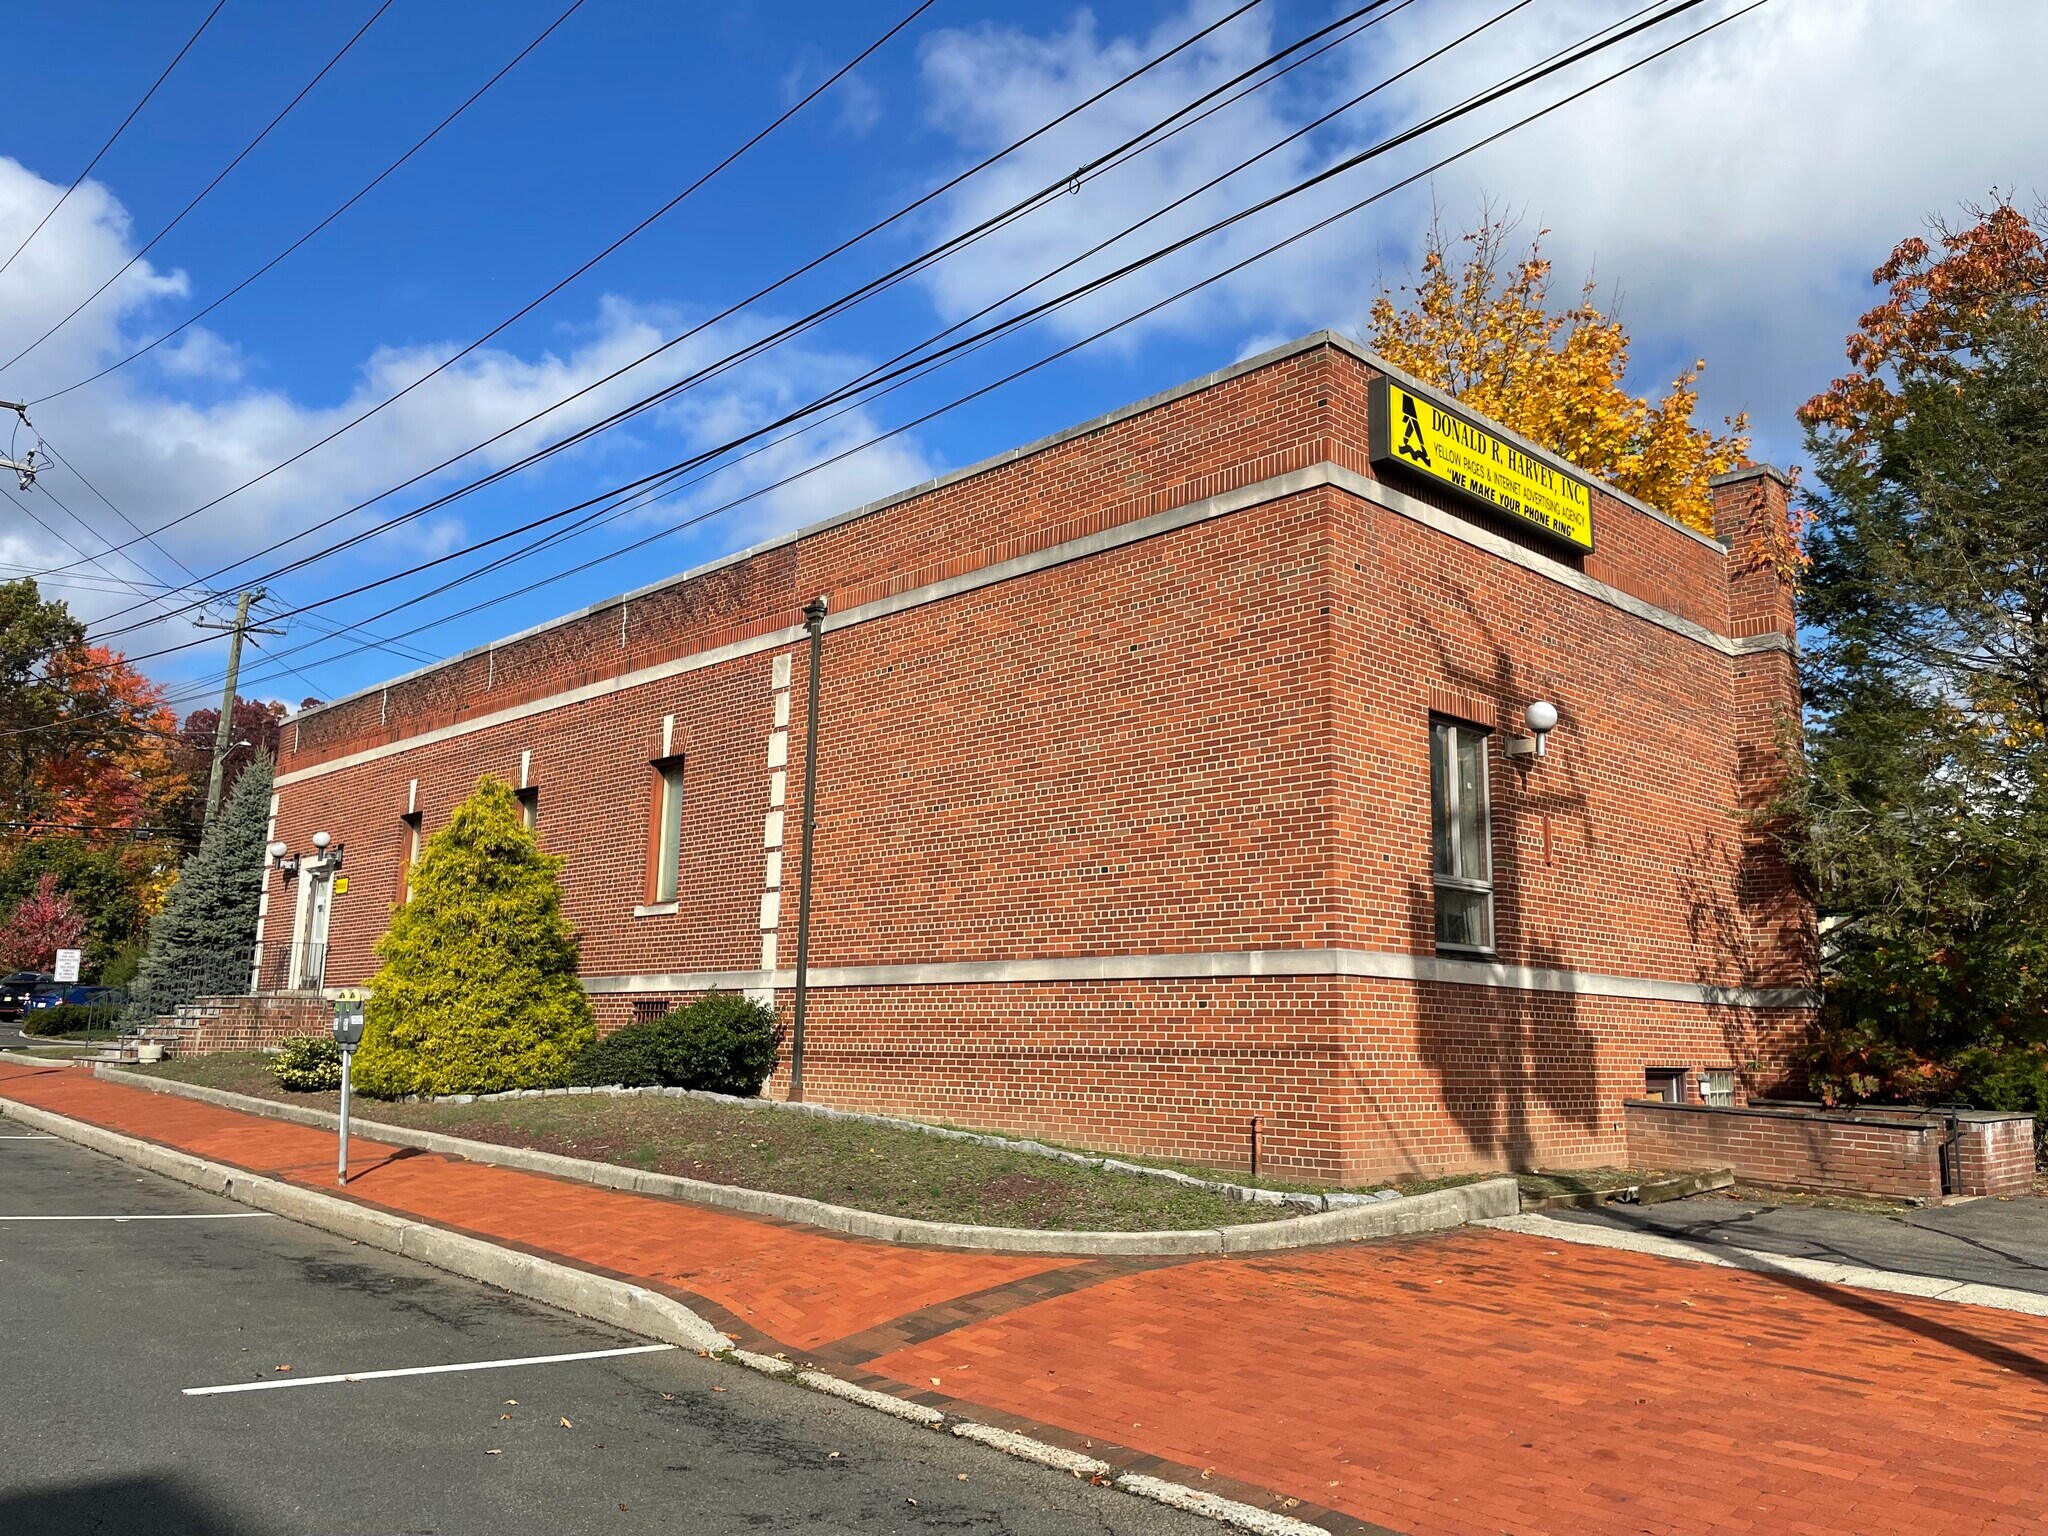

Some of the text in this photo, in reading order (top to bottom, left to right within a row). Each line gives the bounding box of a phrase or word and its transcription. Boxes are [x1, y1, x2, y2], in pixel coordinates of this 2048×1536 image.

[1432, 408, 1585, 506] DONALD R. HARVEY, INC.
[1434, 442, 1585, 527] YELLOW PAGES & INTERNET ADVERTISING AGENCY
[1469, 479, 1496, 501] MAKE
[1499, 492, 1521, 513] YOUR
[1523, 505, 1550, 527] PHONE
